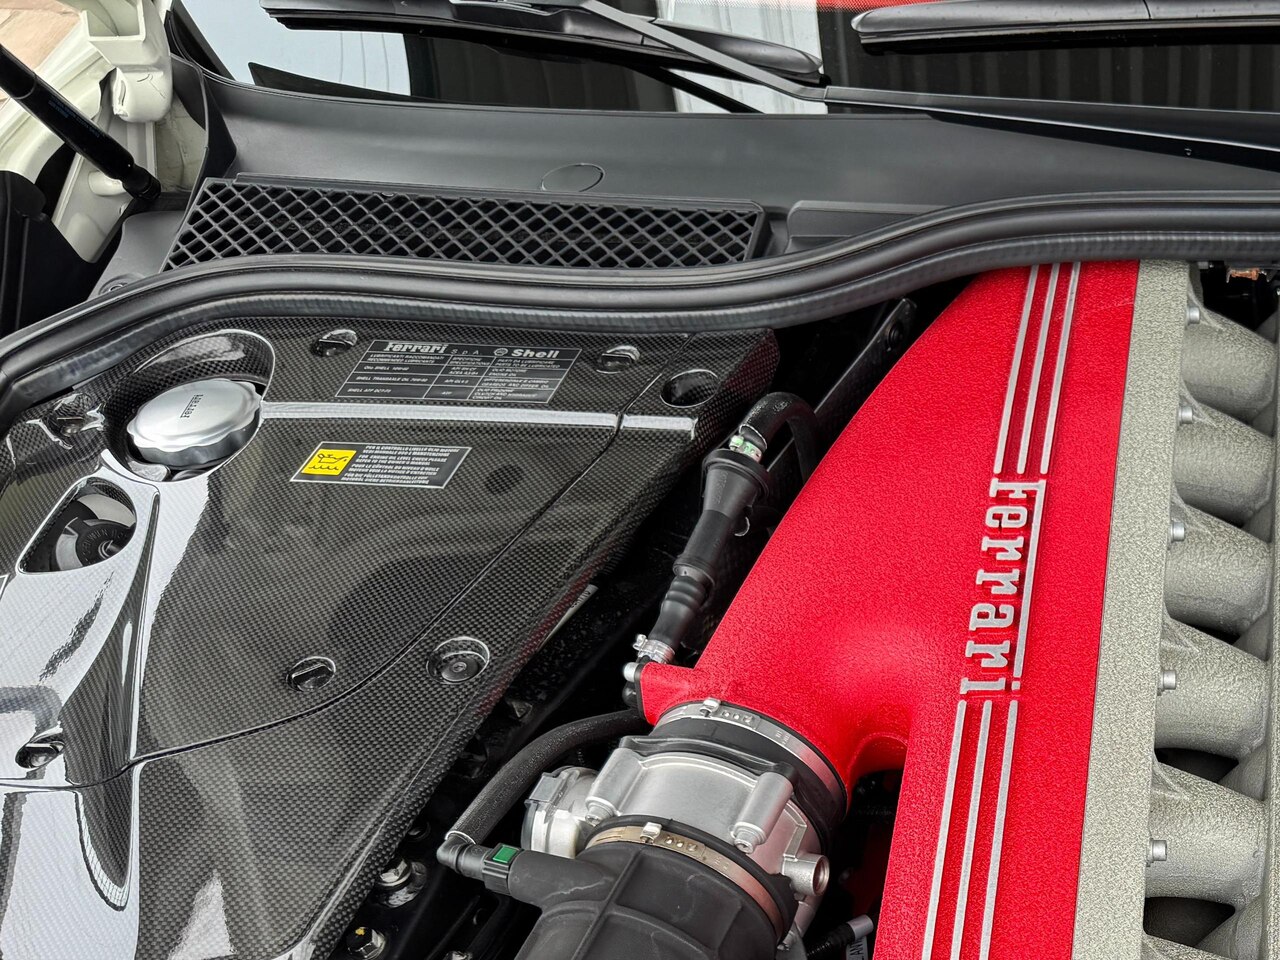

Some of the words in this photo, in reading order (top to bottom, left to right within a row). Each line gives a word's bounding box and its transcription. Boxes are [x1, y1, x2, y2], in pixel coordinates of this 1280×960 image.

[384, 342, 449, 353] Ferrari
[511, 349, 560, 358] Shell
[960, 478, 1047, 695] Ferrari
